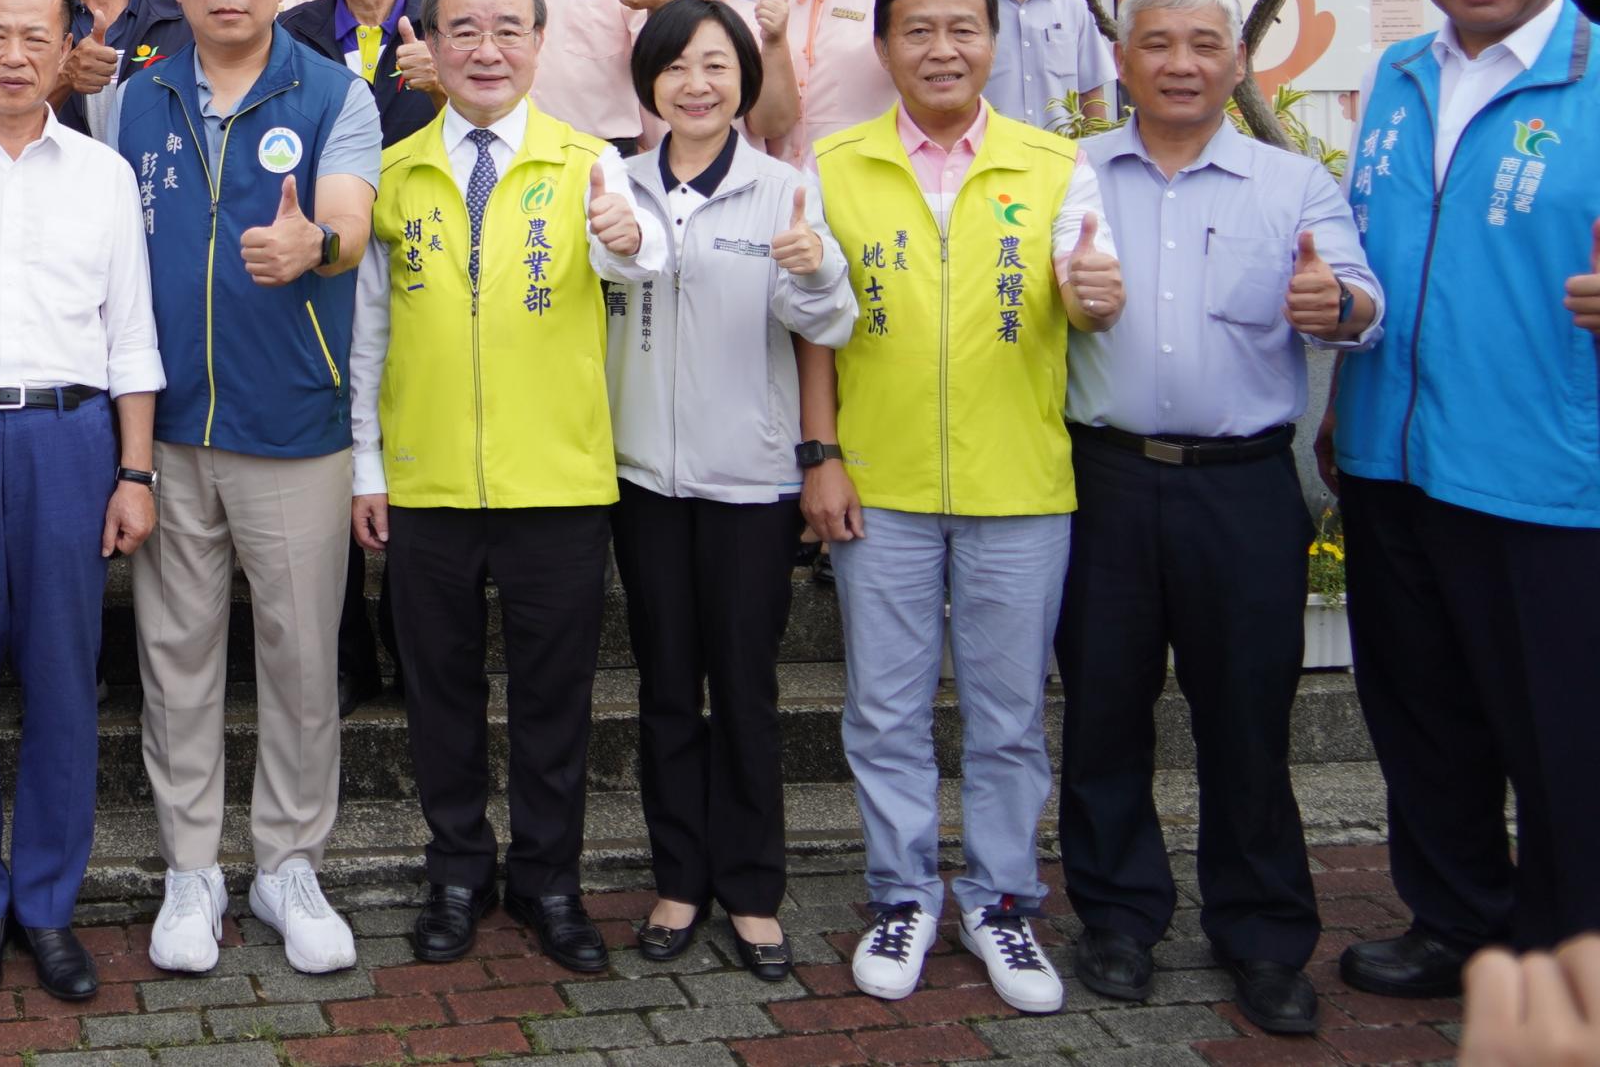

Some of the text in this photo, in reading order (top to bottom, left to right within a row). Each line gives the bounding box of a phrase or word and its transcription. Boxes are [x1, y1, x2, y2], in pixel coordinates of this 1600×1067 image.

[163, 132, 183, 189] 部長
[404, 218, 425, 292] 胡忠一
[428, 207, 443, 252] 次長
[893, 230, 909, 270] 署長
[523, 218, 553, 317] 農業部
[861, 241, 888, 336] 姚士源
[995, 235, 1027, 343] 農糧署
